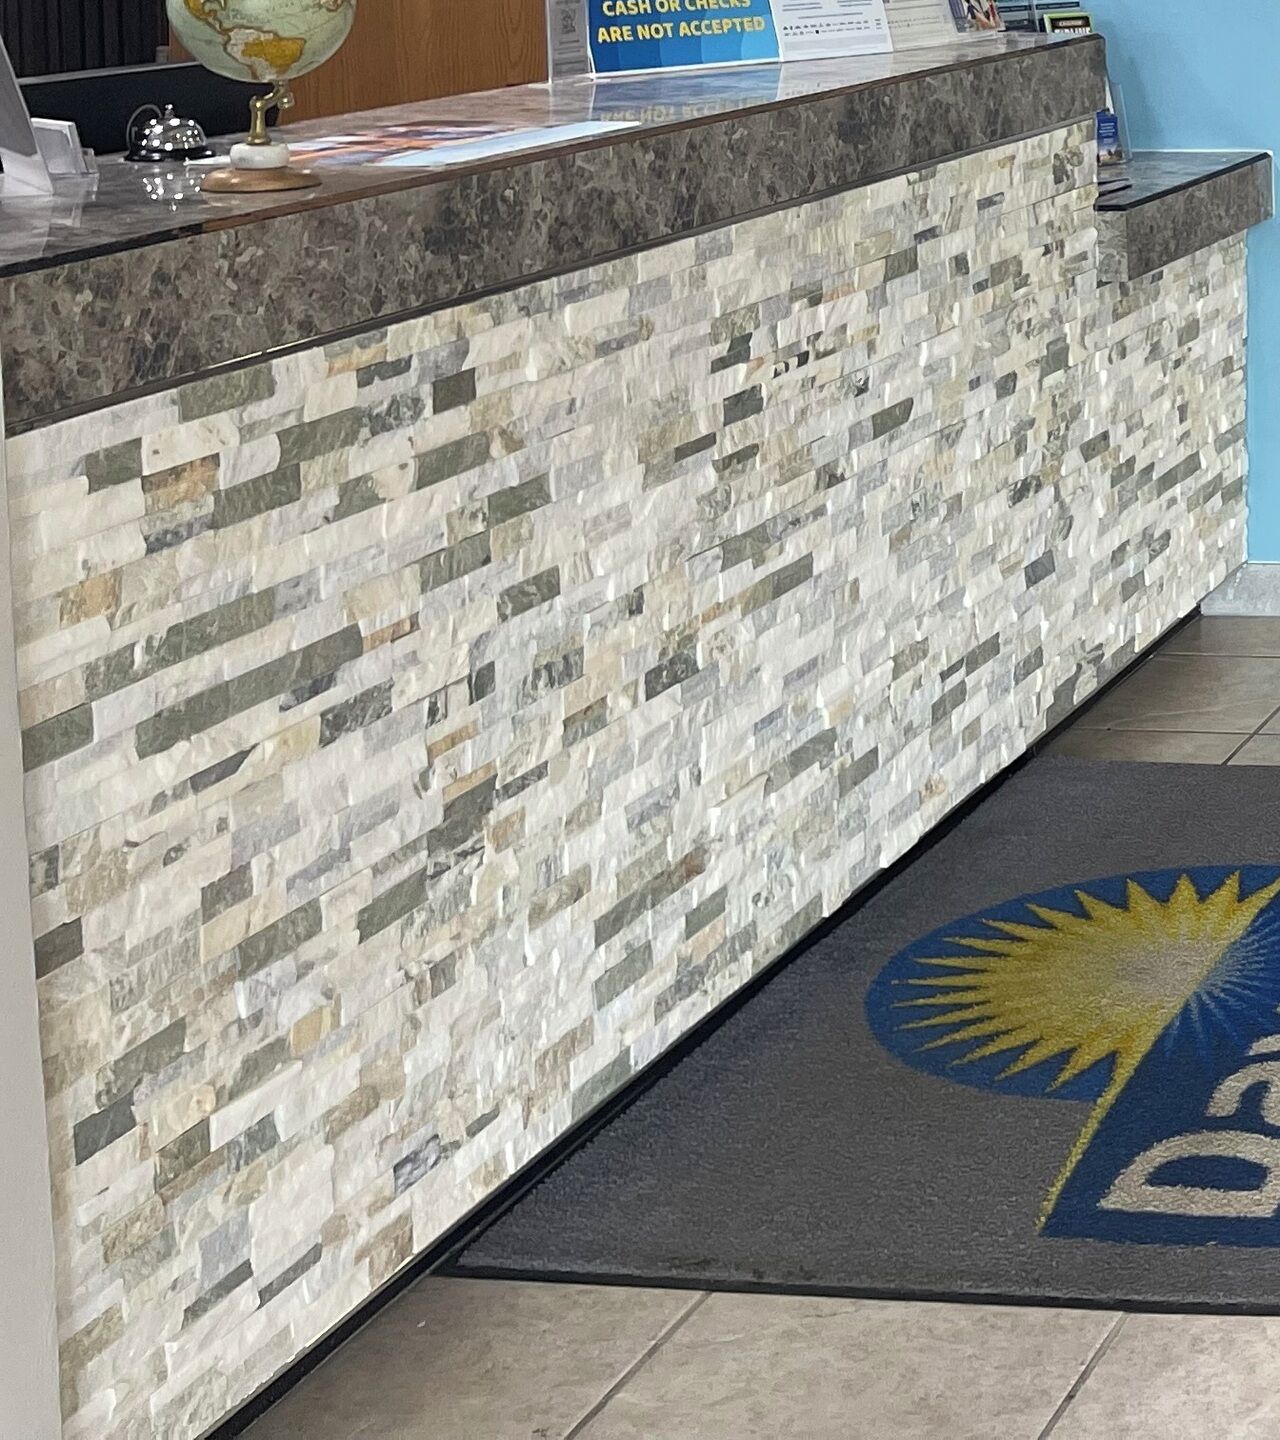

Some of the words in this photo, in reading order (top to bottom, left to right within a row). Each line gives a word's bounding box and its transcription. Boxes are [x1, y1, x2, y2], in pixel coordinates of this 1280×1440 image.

[597, 25, 634, 44] ARE
[636, 22, 675, 40] NOT
[679, 16, 766, 37] ACCEPTED
